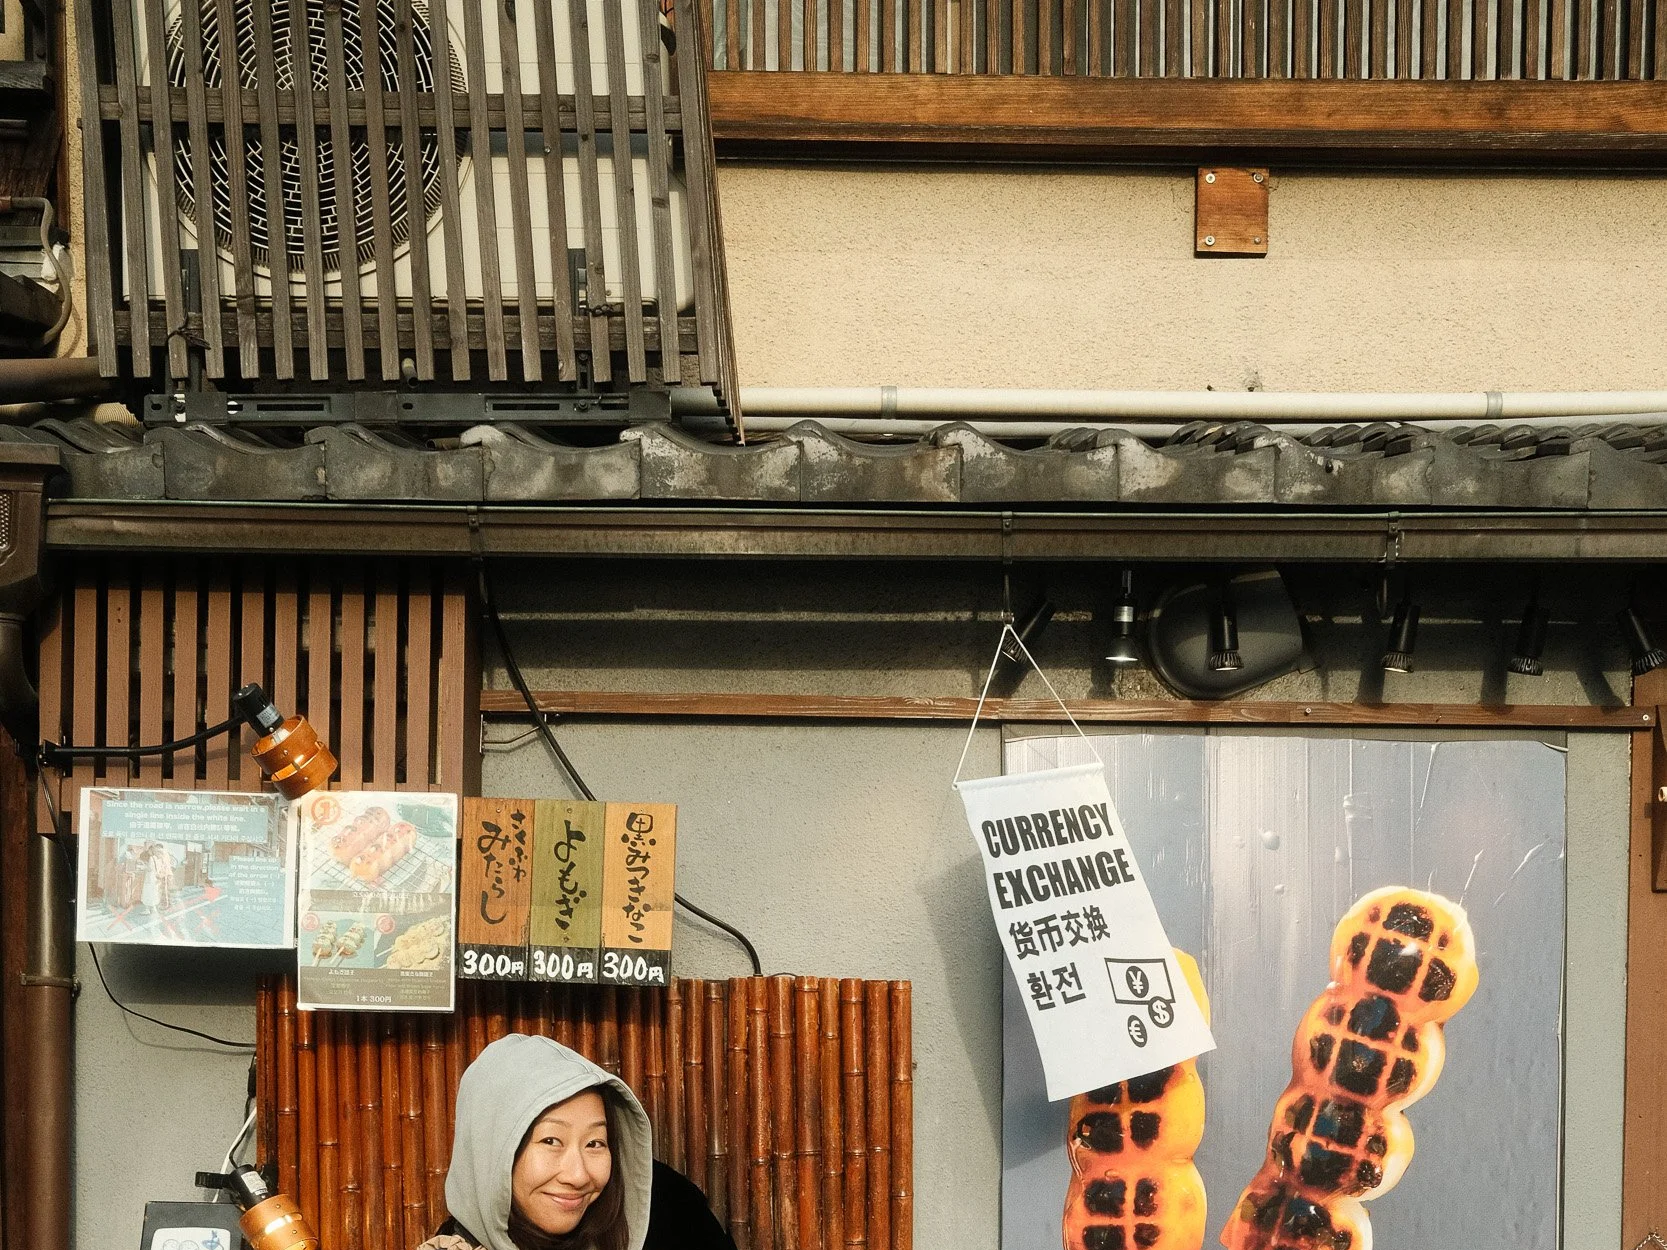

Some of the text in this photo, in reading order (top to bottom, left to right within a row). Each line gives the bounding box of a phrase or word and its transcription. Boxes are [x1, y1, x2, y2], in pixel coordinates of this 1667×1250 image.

[981, 802, 1115, 858] CURRENCY
[477, 821, 511, 925] みたらし
[554, 819, 587, 931] よもぎ
[993, 848, 1135, 909] EXCHANGE
[1008, 904, 1111, 960] 货币交换
[463, 950, 524, 977] 300円
[533, 950, 594, 979] 300円
[602, 952, 665, 983] 300円
[1026, 962, 1087, 1011] 환전
